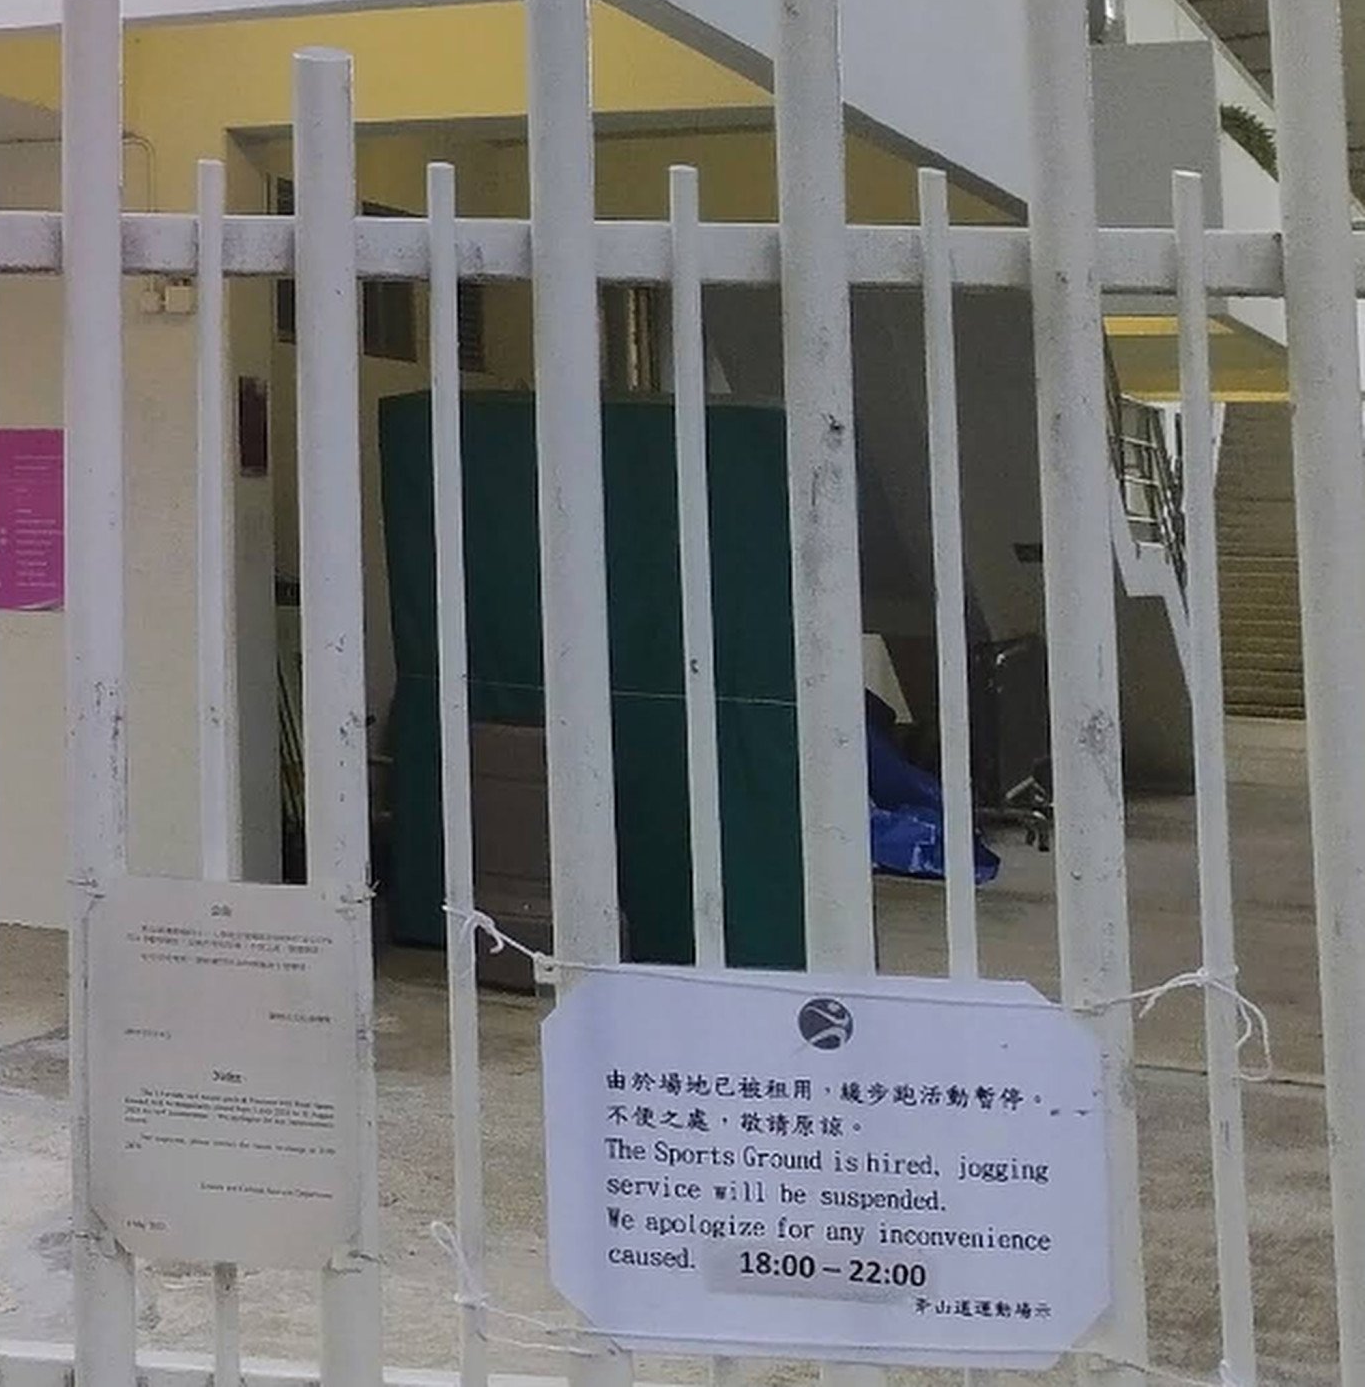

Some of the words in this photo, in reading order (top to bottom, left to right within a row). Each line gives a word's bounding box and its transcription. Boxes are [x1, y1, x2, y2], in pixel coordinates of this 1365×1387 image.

[604, 1138, 645, 1160] The
[655, 1141, 735, 1167] Sports
[743, 1146, 822, 1171] Ground
[835, 1151, 858, 1173] is
[958, 1156, 1050, 1183] jogging
[606, 1176, 701, 1200] service
[713, 1181, 765, 1203] will
[780, 1183, 806, 1205] be
[820, 1189, 947, 1212] suspended.
[607, 1207, 634, 1230] We
[645, 1213, 765, 1239] apologize
[778, 1217, 816, 1240] for
[826, 1224, 865, 1246] any
[880, 1222, 1051, 1251] inconvenience
[608, 1246, 696, 1269] caused.
[740, 1251, 816, 1279] 18:00
[848, 1259, 927, 1287] 22:00
